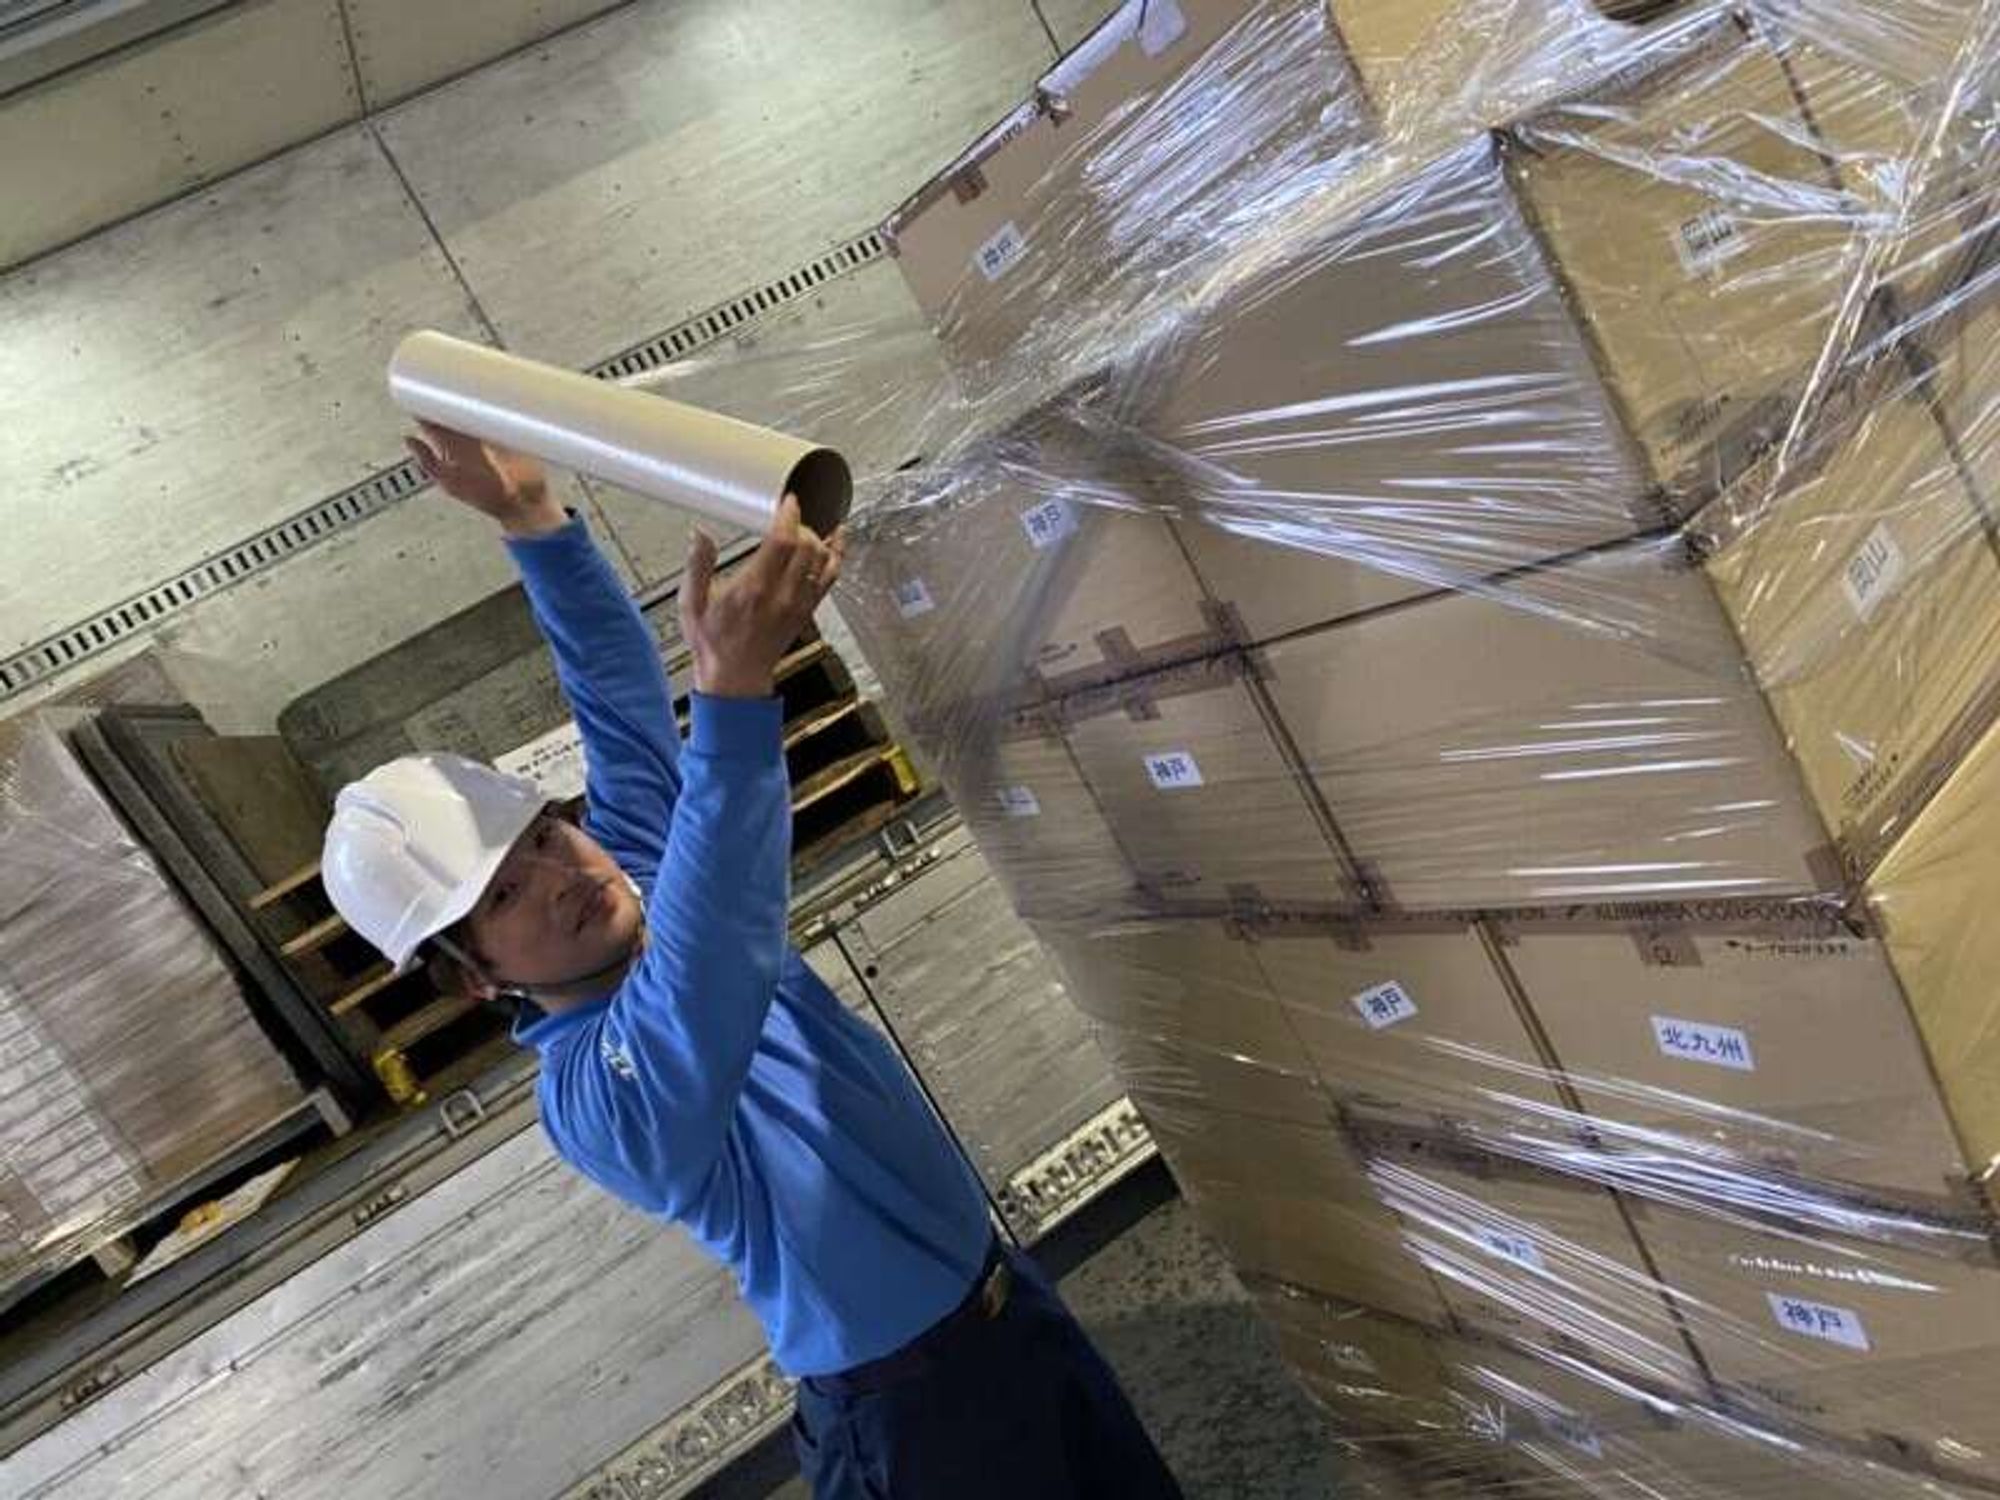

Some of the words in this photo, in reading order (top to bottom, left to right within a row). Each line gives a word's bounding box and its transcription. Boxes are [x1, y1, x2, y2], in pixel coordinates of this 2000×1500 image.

[1027, 504, 1060, 539] 神戸
[1152, 757, 1187, 784] 神戸
[1367, 987, 1401, 1019] 神戸
[1661, 1025, 1744, 1062] 北九州
[1782, 1299, 1842, 1336] 神戸
